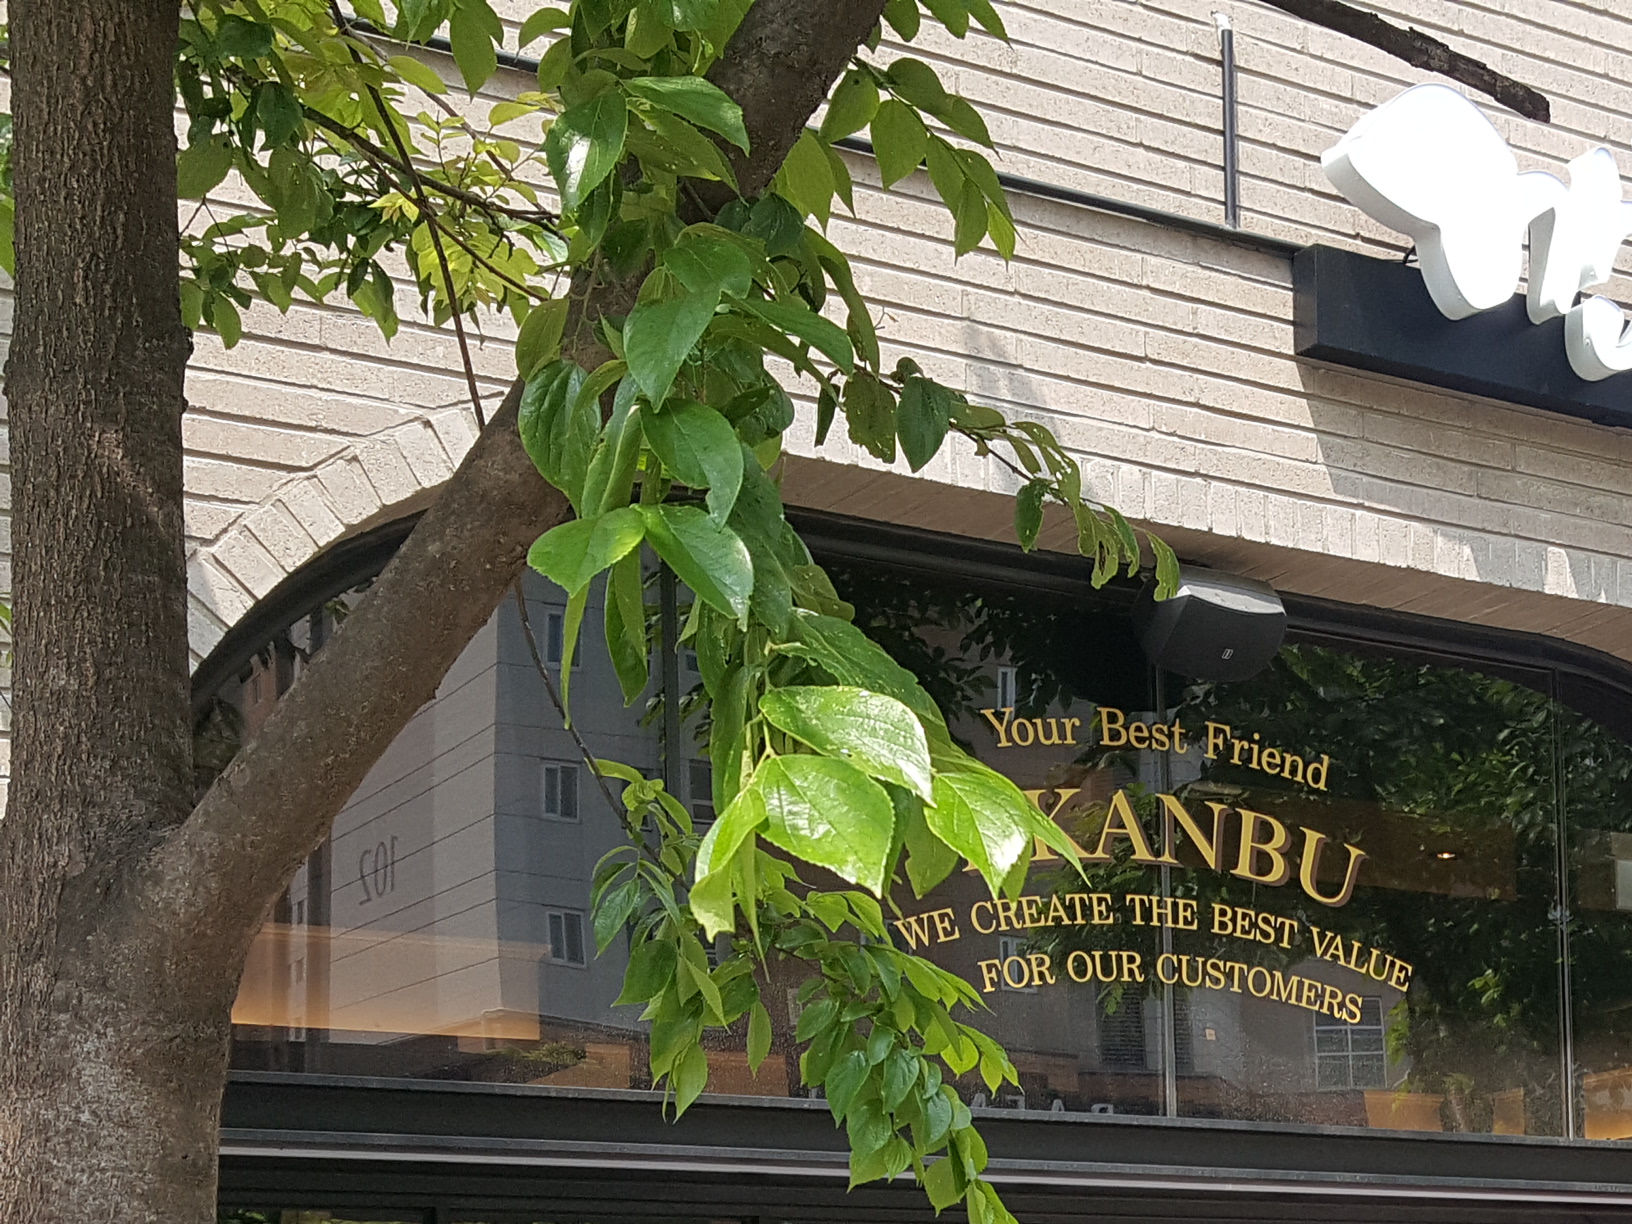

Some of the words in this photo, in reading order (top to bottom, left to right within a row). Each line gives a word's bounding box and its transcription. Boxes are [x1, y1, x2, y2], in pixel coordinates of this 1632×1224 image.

[981, 705, 1081, 750] Your
[1096, 706, 1188, 755] Best
[1203, 720, 1332, 793] Friend
[963, 788, 1369, 907] KANBU
[893, 906, 960, 951] WE
[969, 893, 1114, 936] CREATE
[1125, 893, 1199, 931] THE
[1210, 902, 1299, 949] BEST
[1311, 926, 1414, 993] VALUE
[977, 957, 1057, 993] FOR
[1066, 949, 1146, 984] OUR
[1157, 953, 1365, 1025] CUSTOMERS
